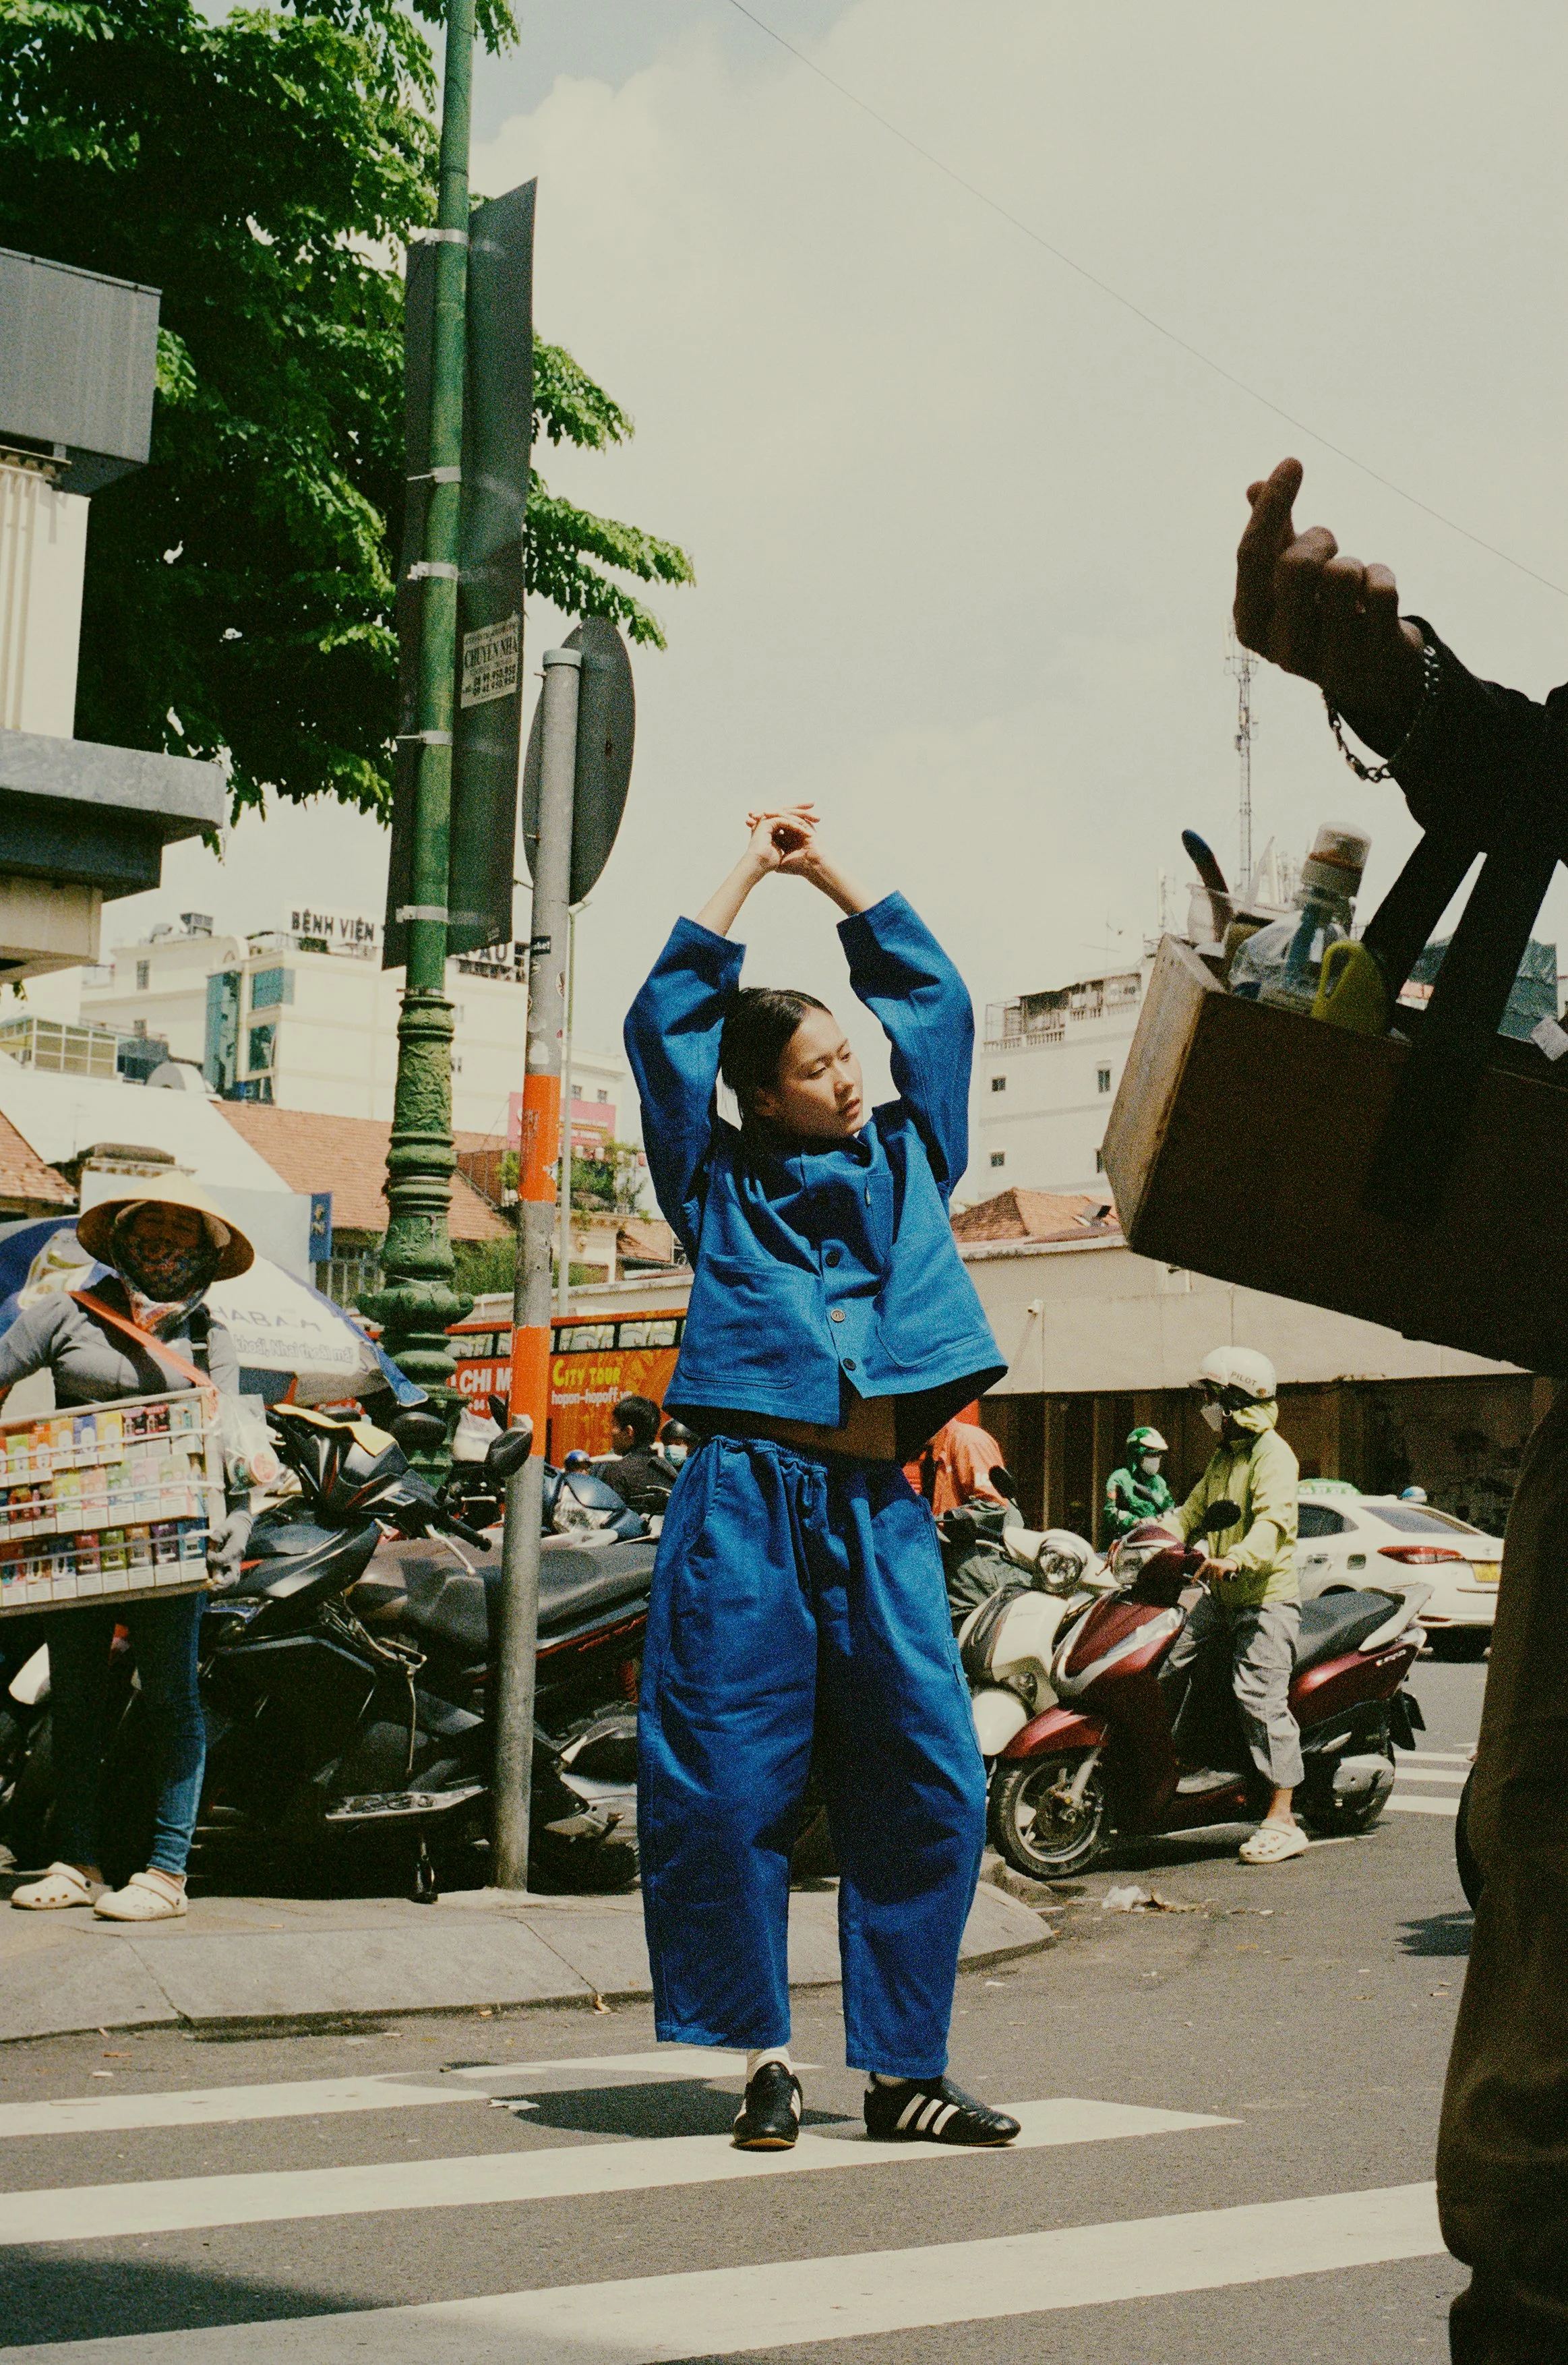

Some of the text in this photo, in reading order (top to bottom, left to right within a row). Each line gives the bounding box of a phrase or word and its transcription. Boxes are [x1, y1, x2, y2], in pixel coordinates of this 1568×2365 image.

[291, 908, 375, 942] BỆNH VIỆN
[1230, 1371, 1257, 1386] PILOT
